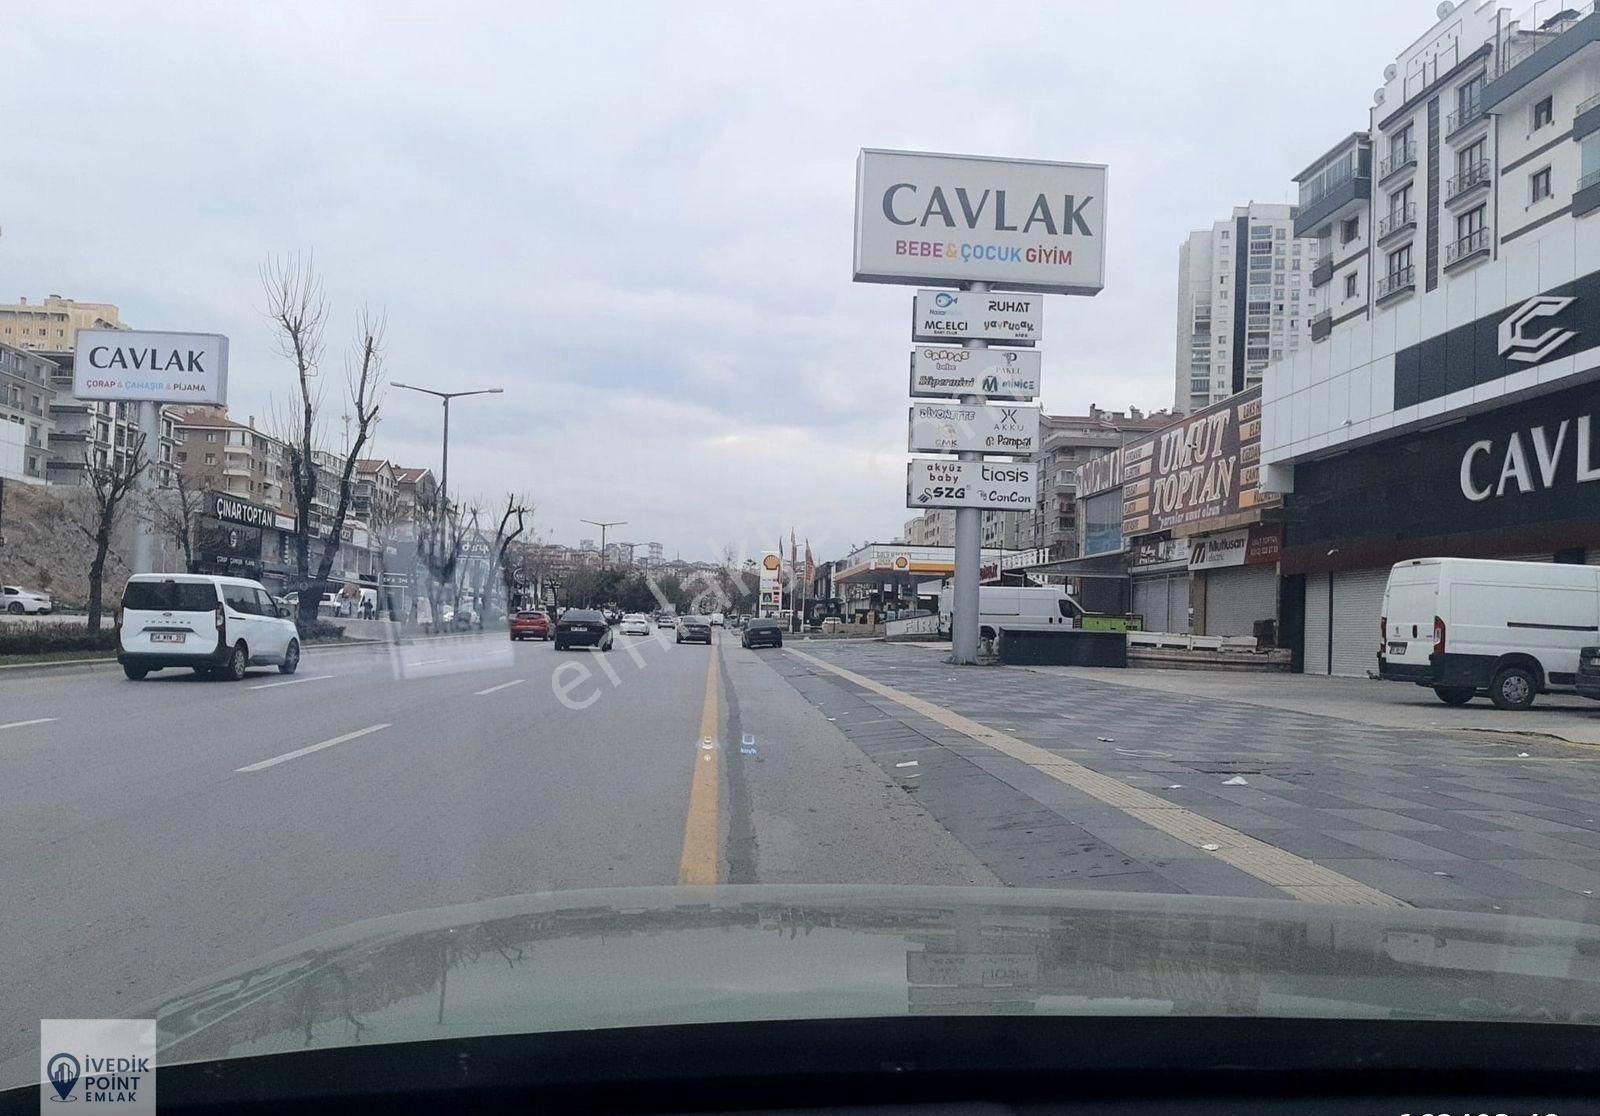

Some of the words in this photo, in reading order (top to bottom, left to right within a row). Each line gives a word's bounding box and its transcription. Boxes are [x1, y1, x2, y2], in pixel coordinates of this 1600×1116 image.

[882, 183, 1094, 237] CAVLAK
[895, 240, 944, 258] BEBE
[946, 244, 957, 258] &
[960, 243, 1022, 263] ÇOCUK
[1025, 245, 1073, 266] GİYİM
[988, 300, 1031, 313] RUHAT
[88, 346, 205, 373] CAVLAK
[86, 380, 116, 390] ÇORAP
[173, 383, 206, 392] PİJAMA
[994, 423, 1024, 431] AKKU
[1158, 408, 1231, 475] UMUT
[1460, 415, 1600, 501] CAVL
[927, 463, 962, 473] akyüz
[981, 465, 1029, 482] tiasis
[930, 473, 959, 484] baby
[1152, 455, 1237, 515] TOPTAN
[932, 487, 965, 499] SZG
[988, 491, 1031, 503] ConCon
